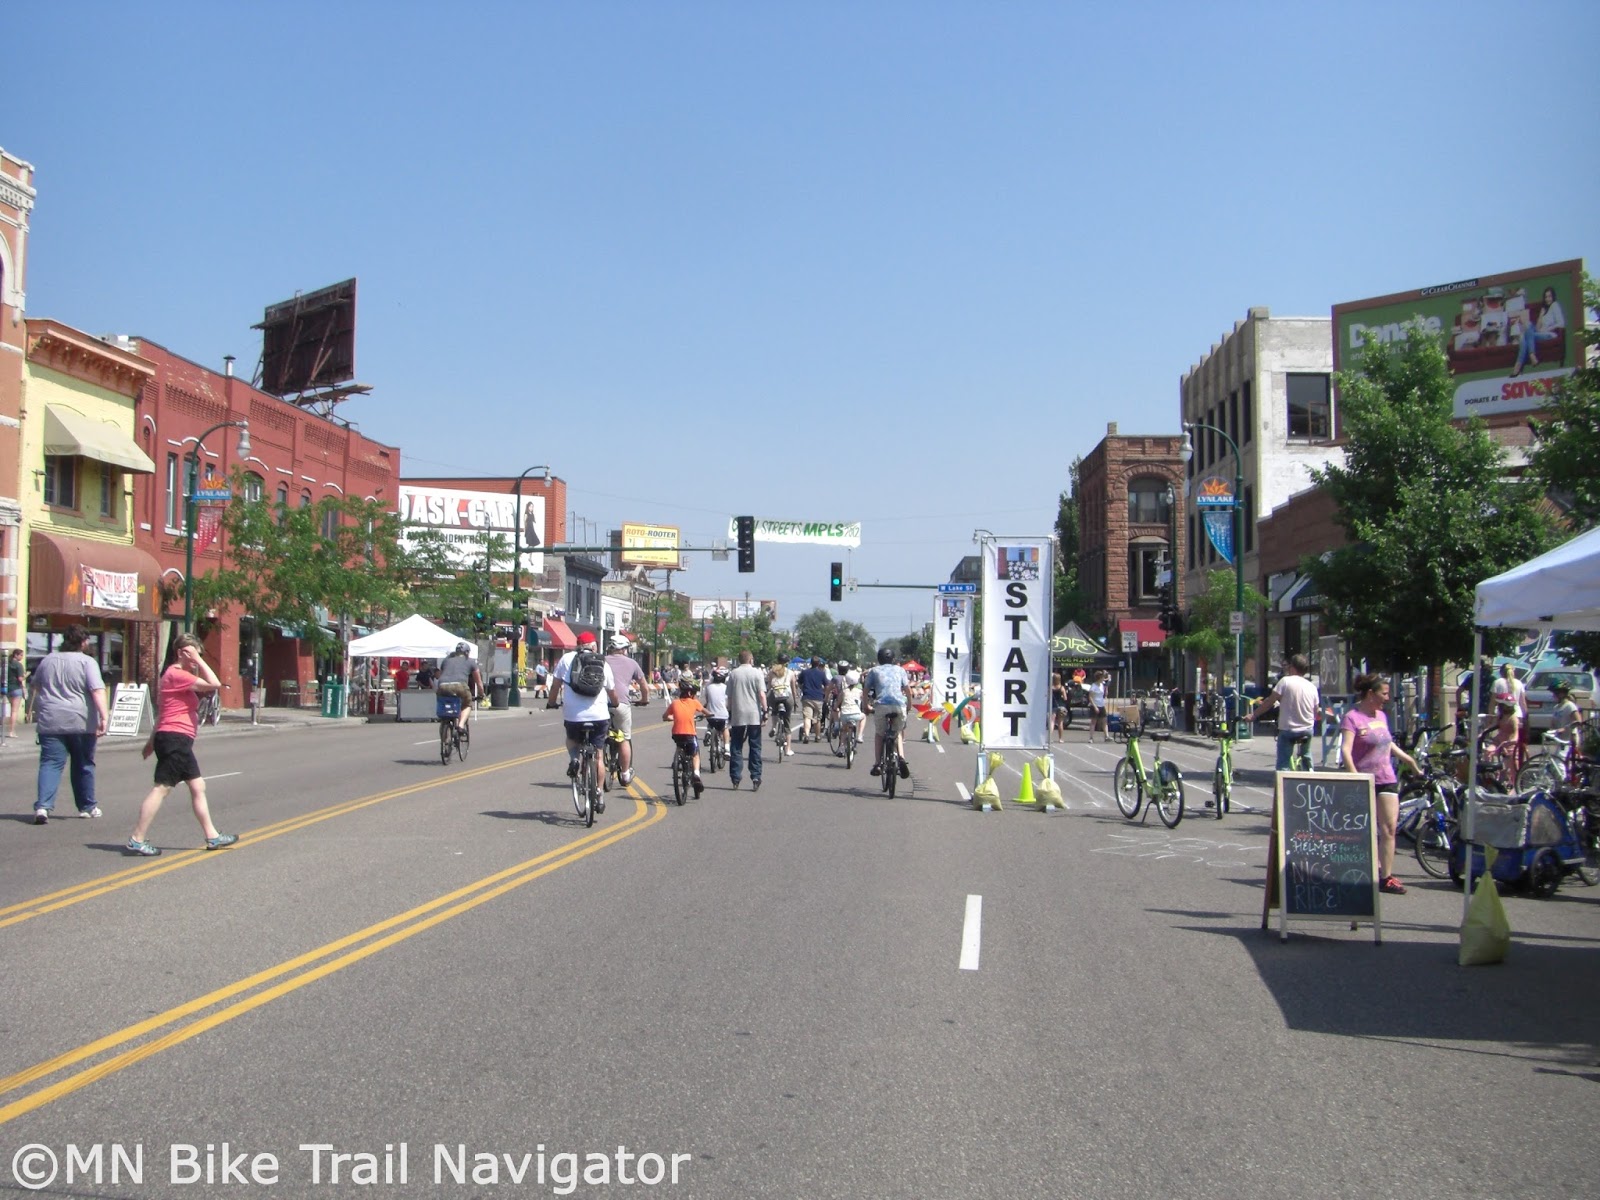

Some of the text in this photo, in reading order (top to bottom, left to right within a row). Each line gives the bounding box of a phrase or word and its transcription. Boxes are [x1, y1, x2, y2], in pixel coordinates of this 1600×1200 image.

[1350, 314, 1441, 349] Donae
[1464, 396, 1490, 406] DONATE
[1491, 395, 1500, 403] AT
[197, 489, 230, 497] LYNLAKE
[1197, 495, 1234, 503] LYNLAKE
[411, 494, 519, 529] ASK-GAR
[625, 528, 677, 539] ROTO-ROOTER
[761, 520, 802, 537] STREETS
[803, 522, 844, 537] MPLS
[946, 617, 959, 704] FINISH
[1002, 582, 1029, 737] START
[1293, 783, 1336, 810] SLOW
[1306, 808, 1369, 833] RACES!
[1294, 841, 1335, 853] HELMET
[1291, 861, 1335, 885] NICE
